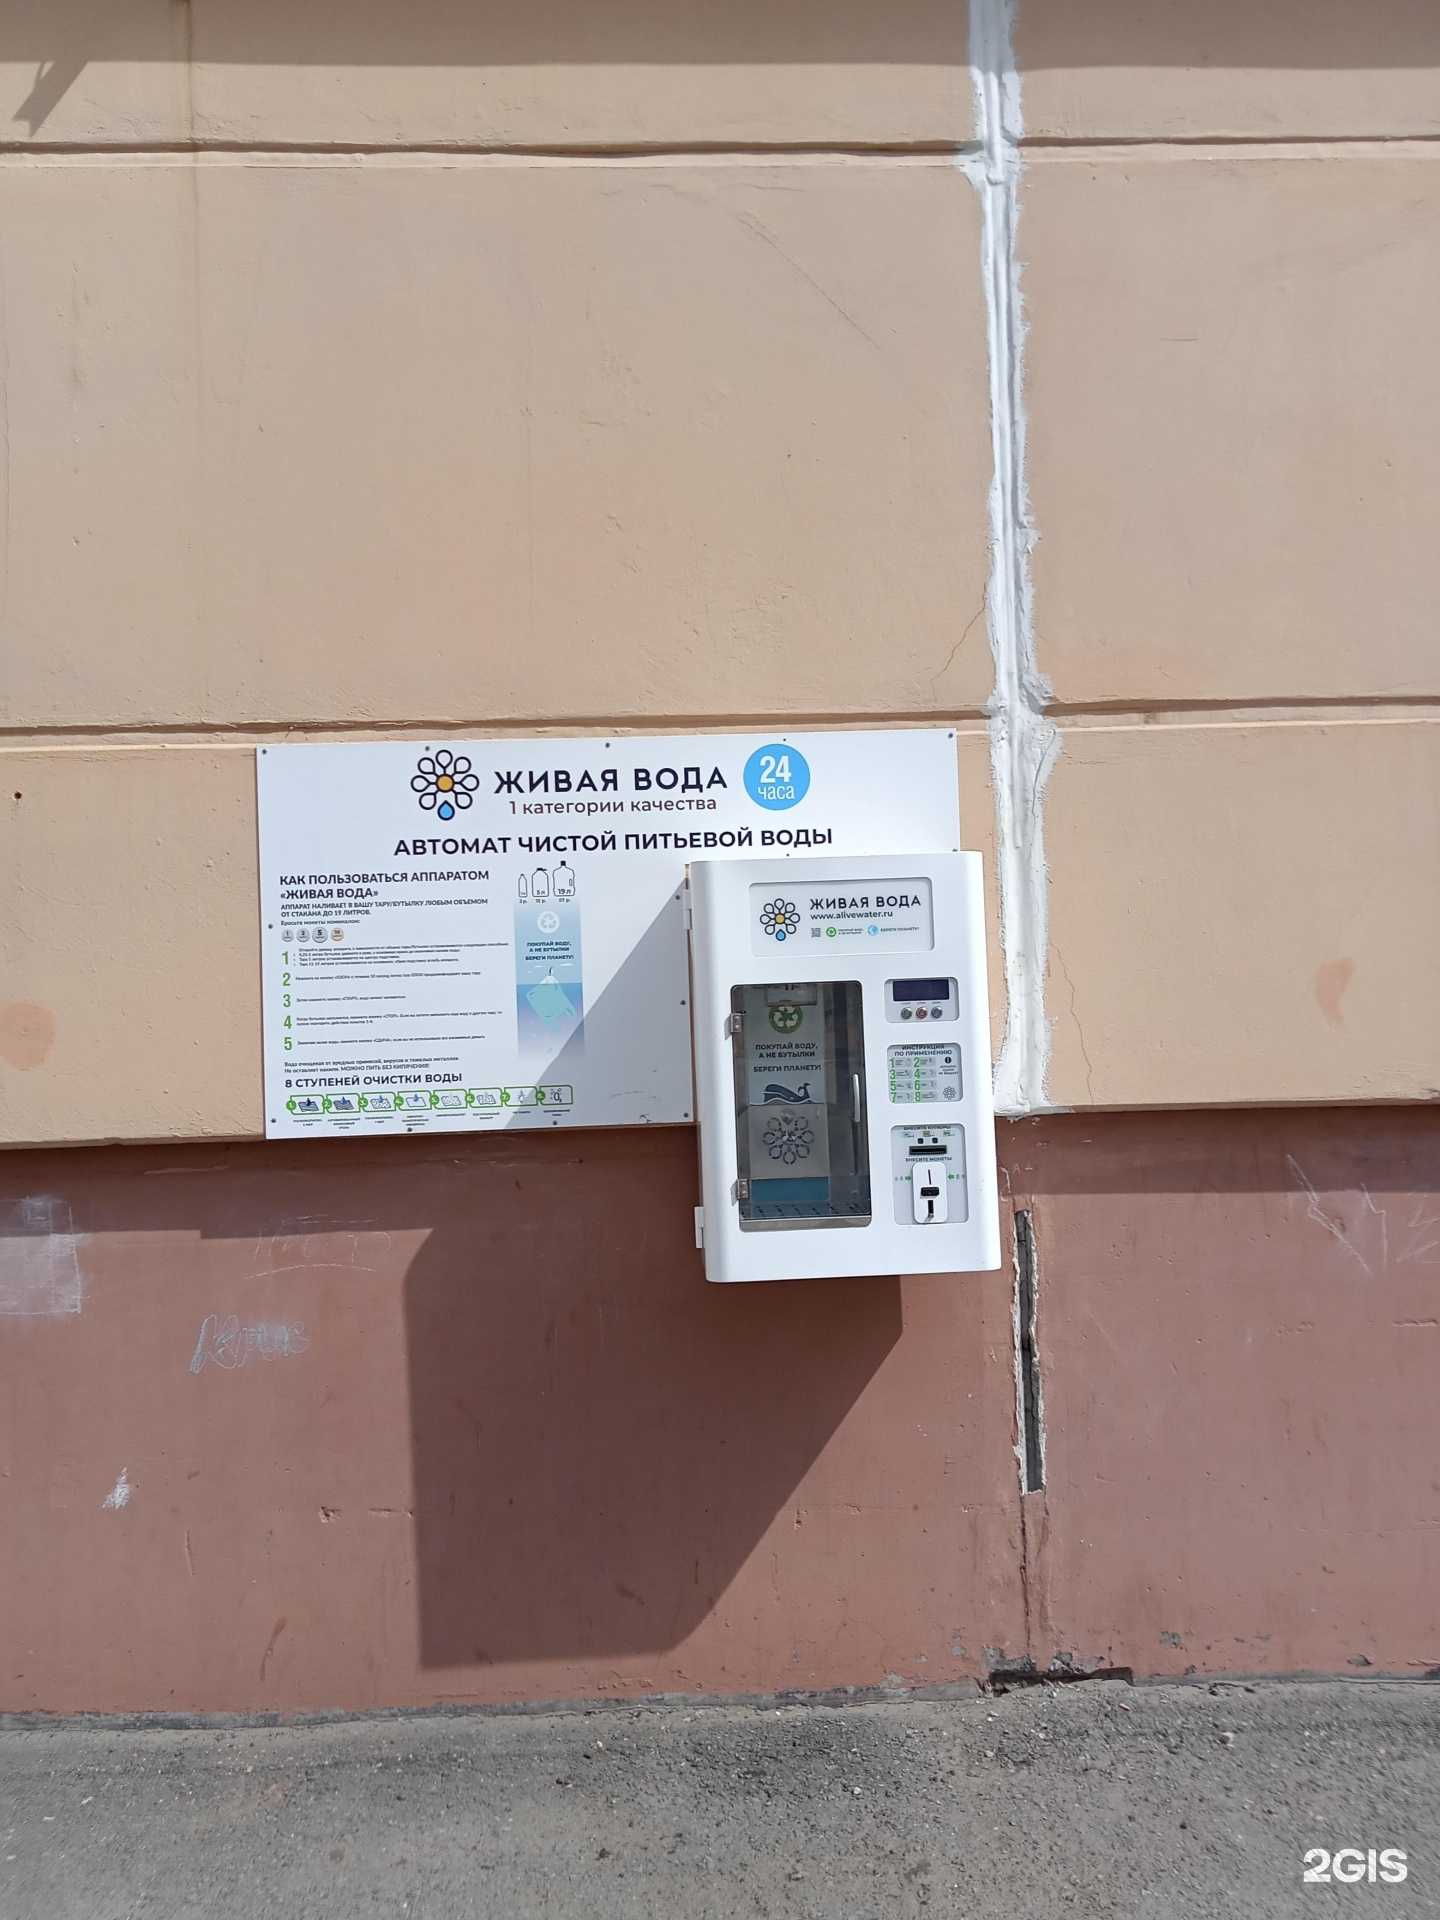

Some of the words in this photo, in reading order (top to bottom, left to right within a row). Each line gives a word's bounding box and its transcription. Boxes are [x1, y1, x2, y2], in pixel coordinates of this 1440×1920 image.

[760, 756, 792, 783] 24
[494, 769, 618, 794] ЖИВАЯ
[634, 767, 728, 793] ВОДА
[758, 785, 795, 800] часа
[510, 802, 516, 814] 1
[523, 801, 624, 816] категории
[631, 798, 717, 812] качества
[394, 837, 511, 855] АВТОМАТ
[518, 830, 616, 852] ЧИСТОЙ
[625, 826, 752, 850] ПИТЬЕВОЙ
[761, 828, 832, 848] ВОДЫ
[280, 875, 306, 885] КАК
[308, 873, 408, 885] ПОЛЬЗОВАТЬСЯ
[411, 871, 489, 882] АППАРАТОМ
[280, 889, 334, 899] «ЖИВАЯ
[337, 888, 378, 899] ВОДА»
[810, 897, 869, 910] ЖИВАЯ
[876, 895, 920, 908] ВОДА
[811, 911, 893, 920] www.alivewater.ru
[282, 951, 288, 965] 1
[282, 973, 290, 986] 2
[283, 994, 291, 1007] 3
[283, 1016, 292, 1029] 4
[284, 1037, 292, 1050] 5
[755, 1042, 792, 1050] ПОКУПАЙ
[913, 1057, 920, 1067] 2
[285, 1080, 292, 1088] 8
[296, 1075, 360, 1087] СТУПЕНЕЙ
[364, 1074, 421, 1085] ОЧИСТКИ
[425, 1073, 462, 1083] ВОДЫ
